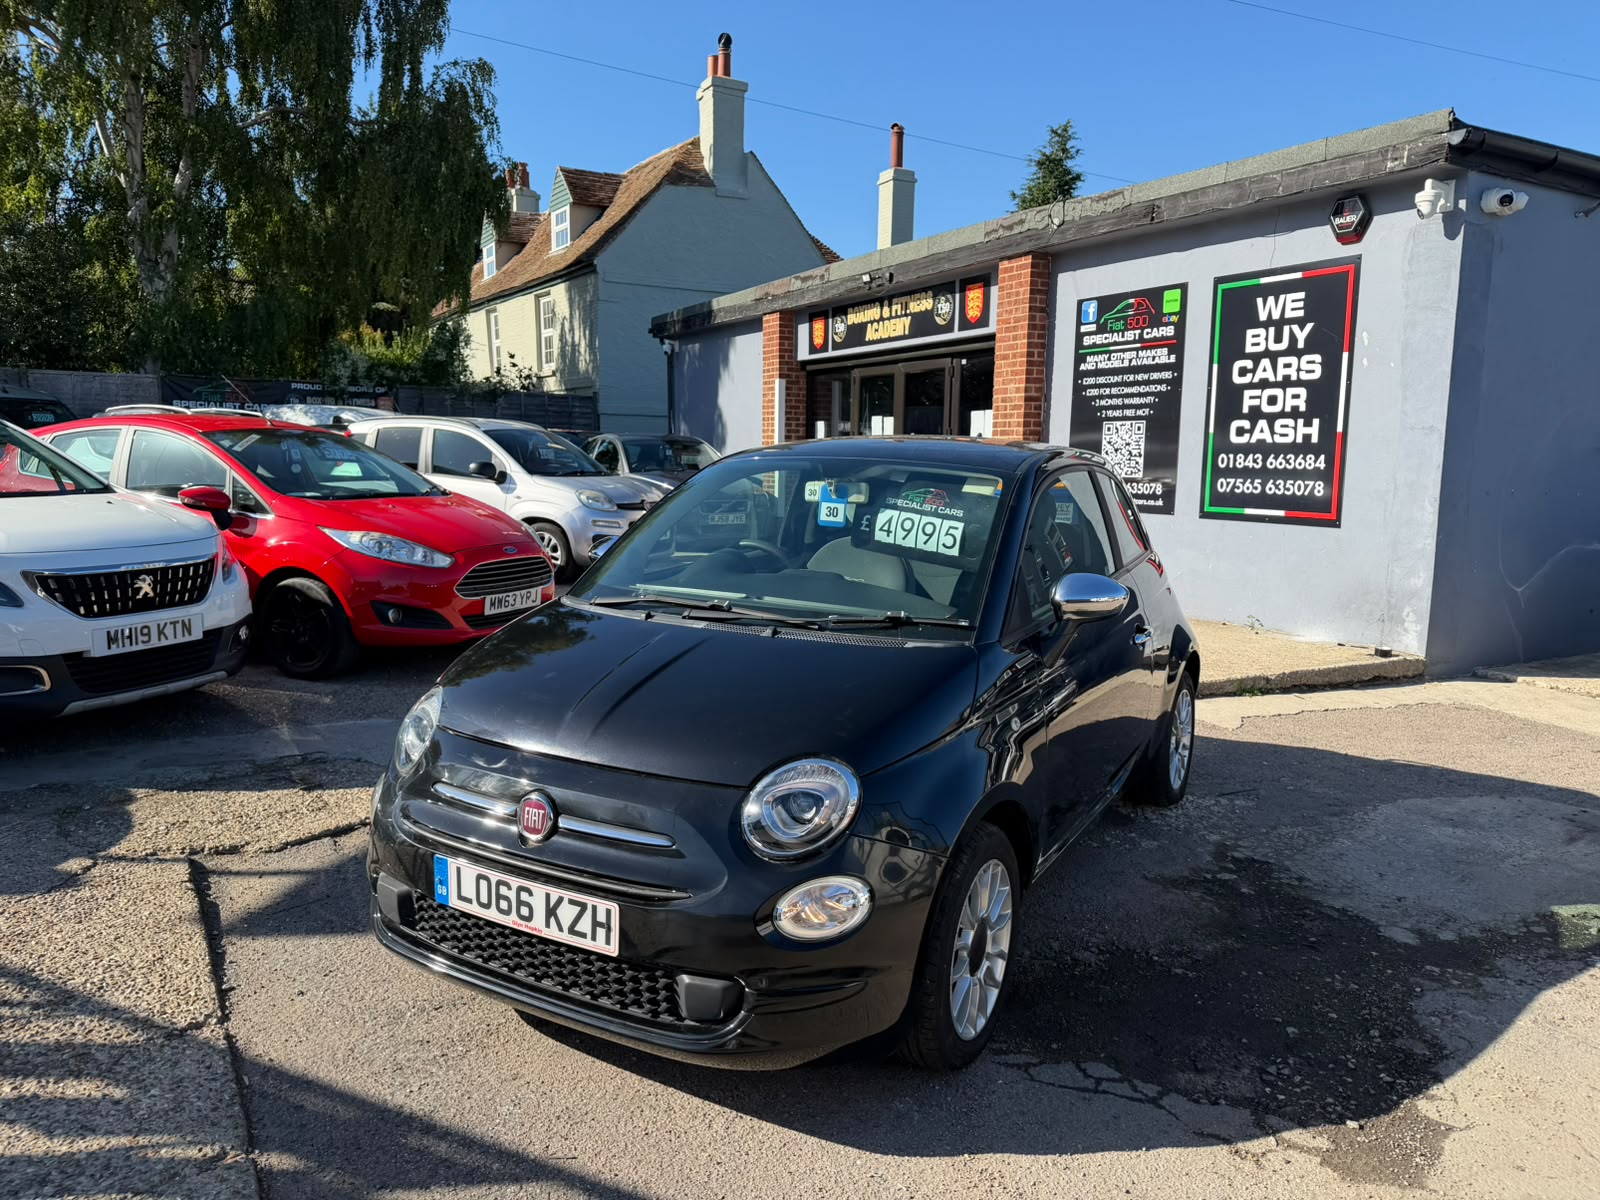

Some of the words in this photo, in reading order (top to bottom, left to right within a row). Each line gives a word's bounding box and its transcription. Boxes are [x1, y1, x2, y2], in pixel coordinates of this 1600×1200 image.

[1335, 215, 1356, 224] BAUER
[847, 302, 880, 325] BOXING
[882, 300, 890, 318] &
[892, 290, 934, 316] FITNESS
[1256, 292, 1306, 321] WE
[866, 316, 912, 342] ACADEMY
[1108, 319, 1124, 332] Fiat
[1127, 315, 1149, 328] 500
[1083, 330, 1141, 346] SPECIALIST
[1144, 326, 1174, 339] CARS
[1244, 322, 1314, 353] BUY
[1080, 362, 1096, 370] AND
[1098, 360, 1129, 369] MODELS
[1130, 354, 1176, 366] AVAILABLE
[1086, 354, 1109, 362] MANY
[1110, 351, 1136, 360] OTHER
[1138, 348, 1168, 358] MAKES
[1096, 375, 1122, 384] DISCOUNT
[1123, 374, 1134, 382] FOR
[1135, 373, 1148, 381] NEW
[1150, 371, 1172, 380] DRIVERS
[1232, 354, 1322, 384] CARS
[1111, 384, 1166, 394] RECOMMENDATIONS
[172, 400, 241, 410] SPECIALIST
[1100, 398, 1122, 406] MONTHS
[1124, 396, 1154, 404] WARRANTY
[1242, 387, 1308, 414] FOR
[1136, 408, 1150, 416] MOT
[1229, 418, 1320, 444] CASH
[1218, 454, 1262, 468] 01843
[1266, 454, 1326, 470] 663684
[1217, 478, 1262, 494] 07565
[1265, 480, 1324, 496] 635078
[826, 506, 839, 518] 30
[886, 497, 937, 512] SPECIALIST
[938, 506, 964, 517] CARS
[106, 624, 152, 650] MH19
[157, 618, 192, 642] KTN
[524, 808, 544, 830] FIAT
[437, 884, 447, 896] GB
[456, 866, 534, 923] LO66
[544, 892, 612, 946] KZH
[511, 920, 524, 929] Glyn
